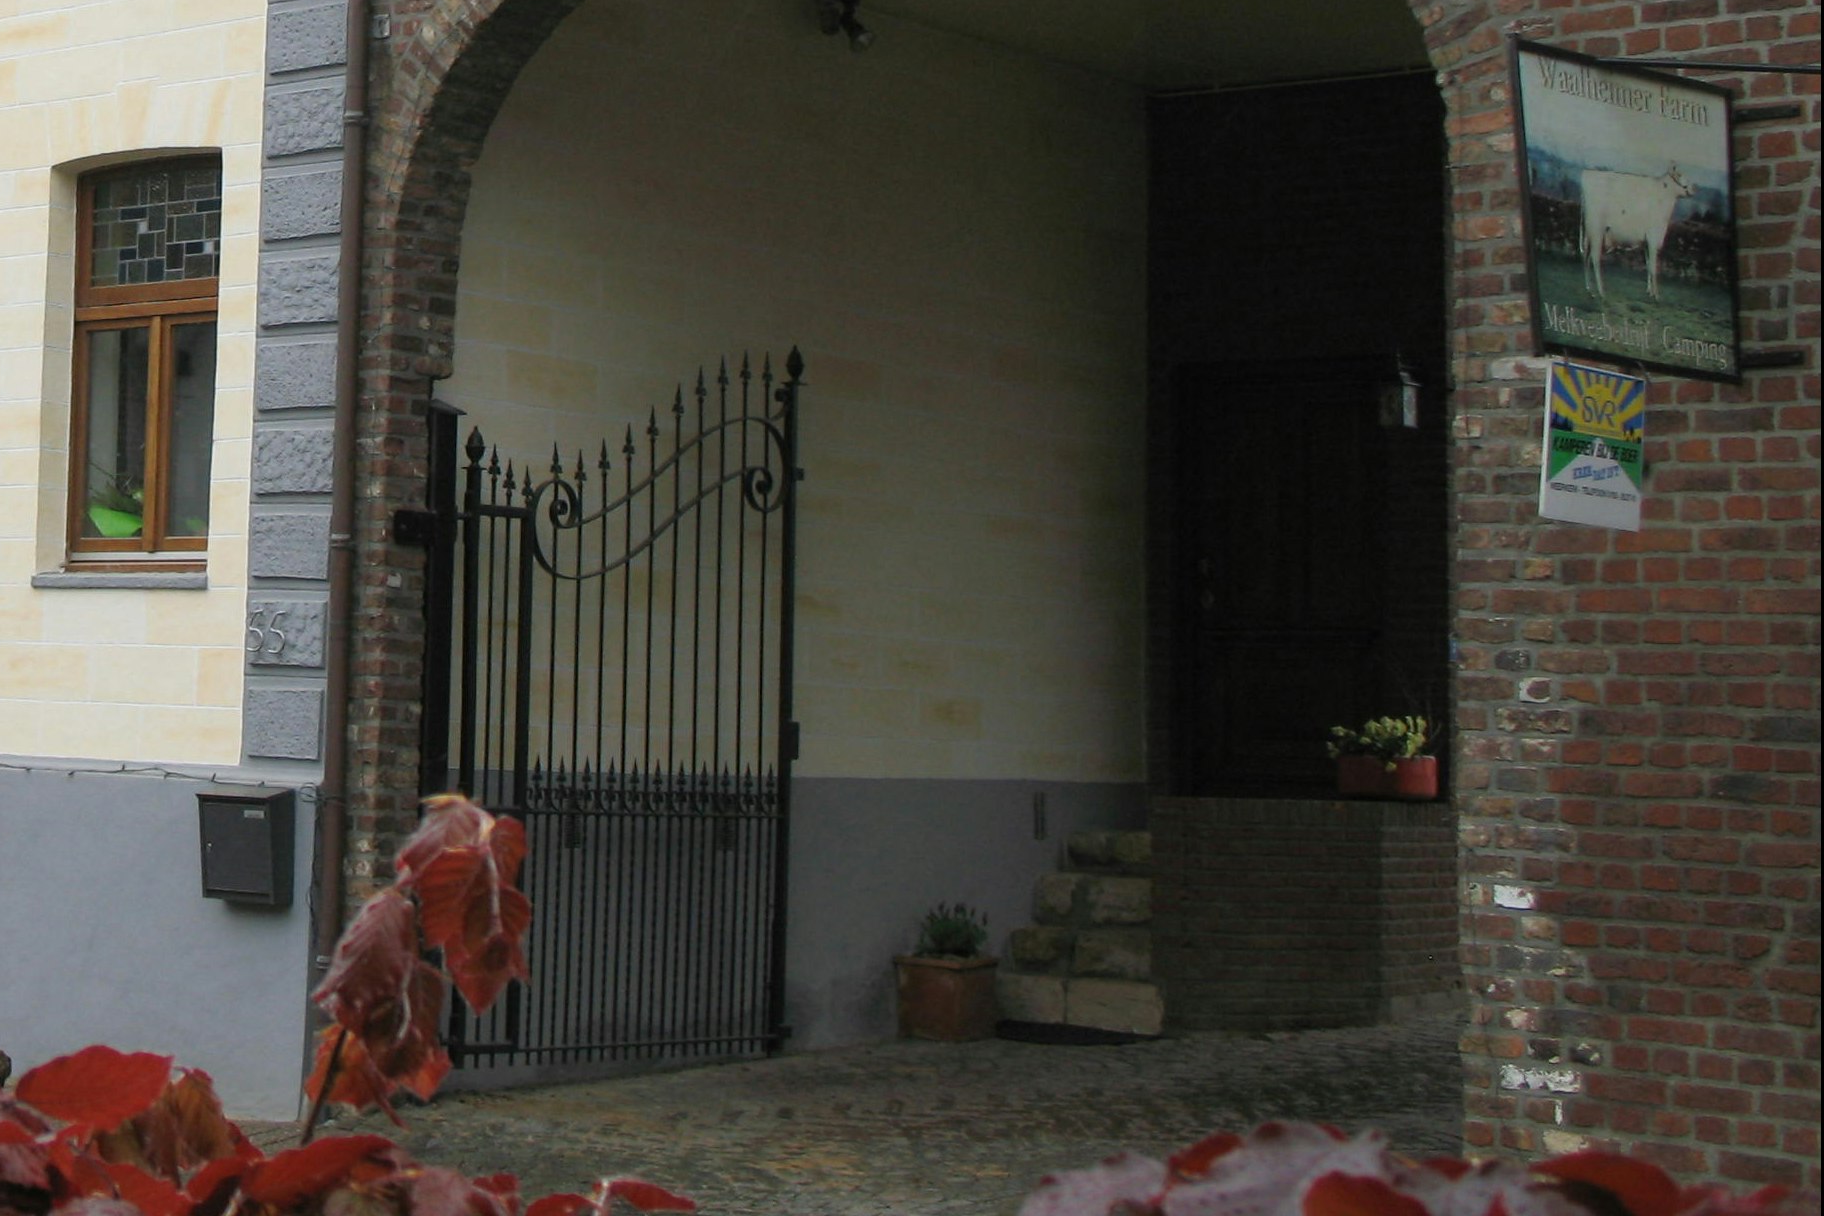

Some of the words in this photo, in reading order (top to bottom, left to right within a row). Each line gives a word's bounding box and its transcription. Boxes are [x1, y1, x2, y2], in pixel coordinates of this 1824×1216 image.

[1659, 85, 1709, 126] Farm
[1663, 326, 1728, 370] Camping
[1582, 396, 1616, 428] SVR
[246, 609, 286, 654] 55
